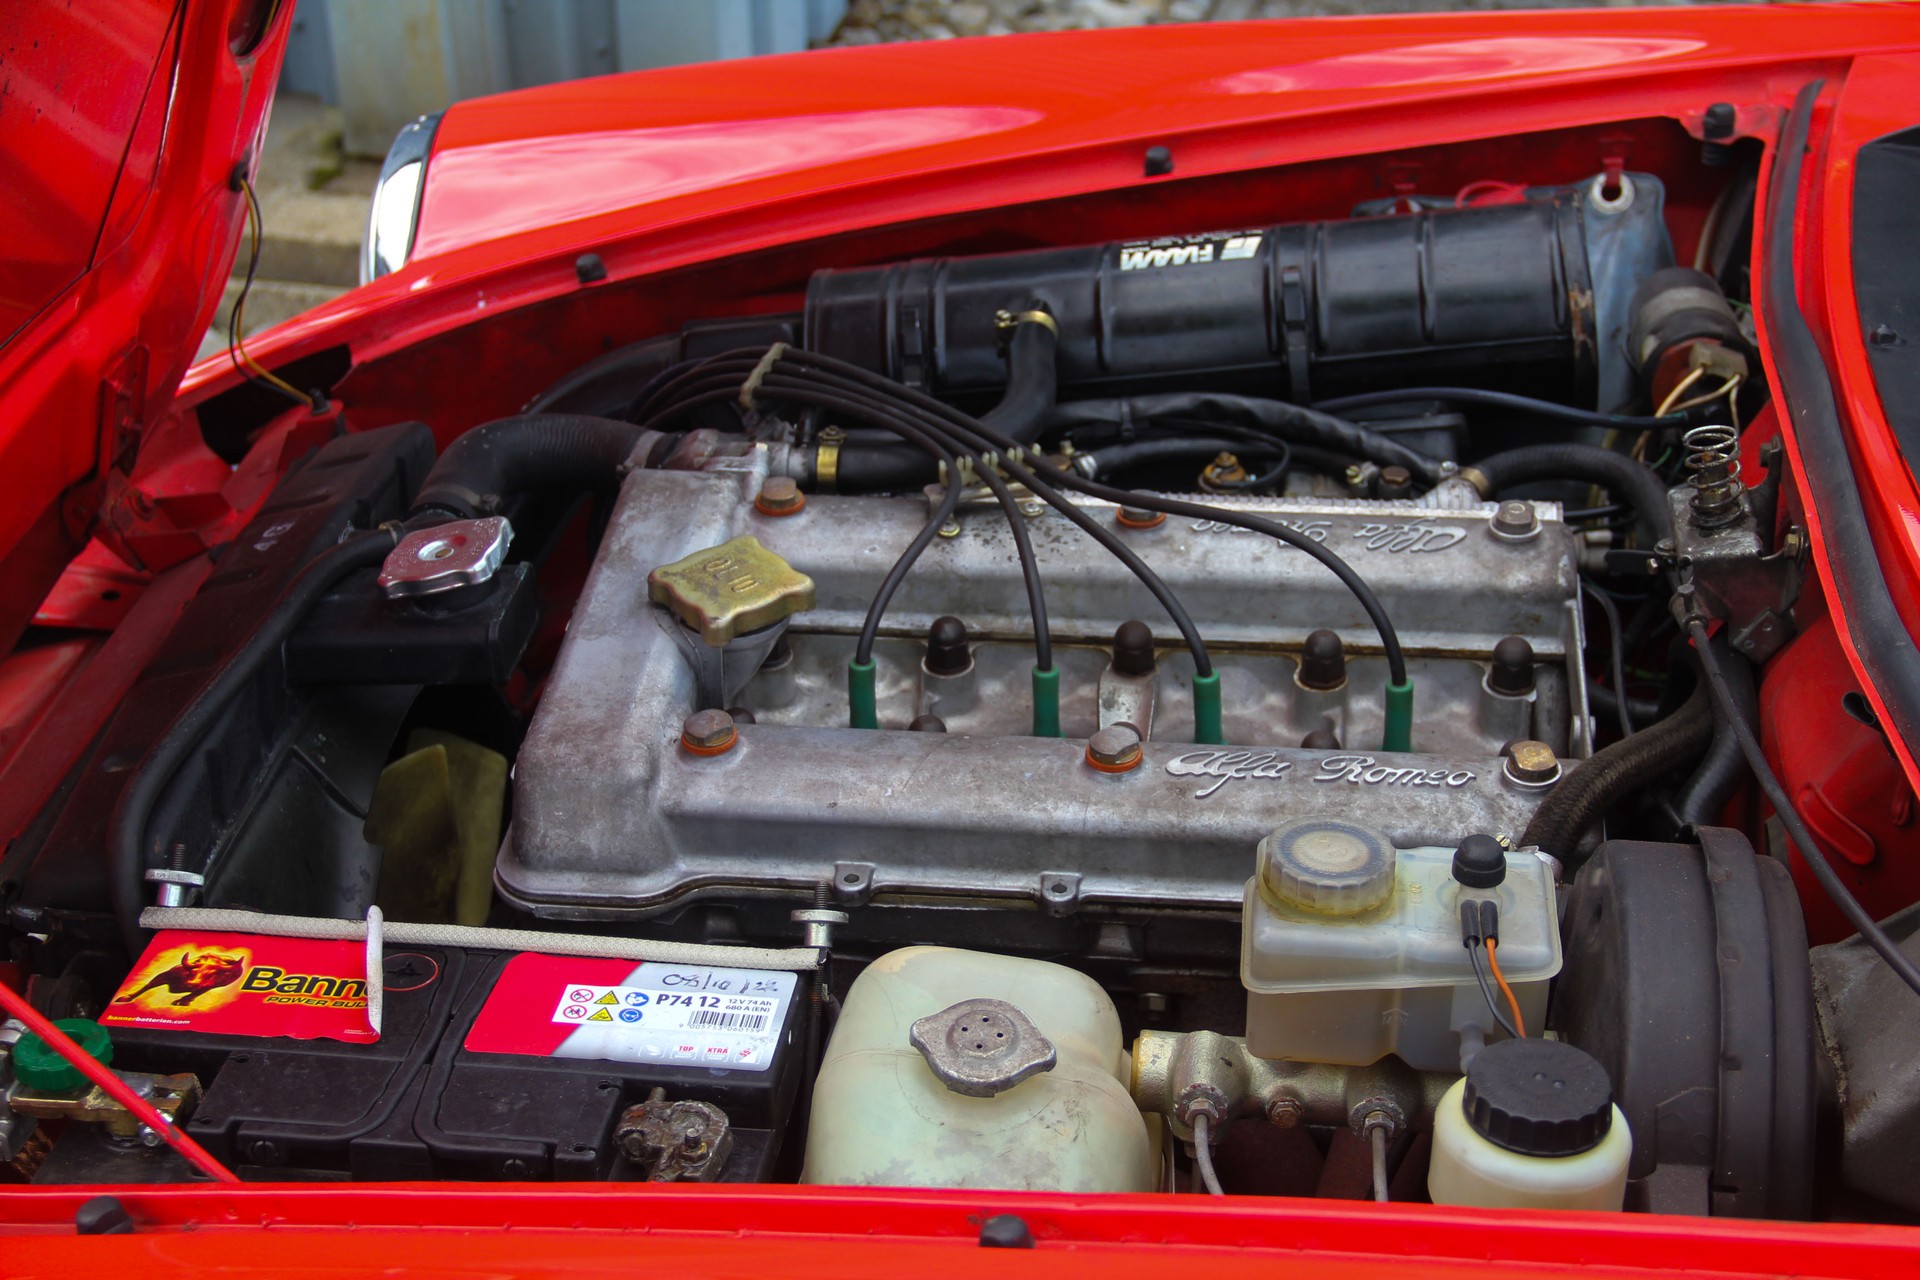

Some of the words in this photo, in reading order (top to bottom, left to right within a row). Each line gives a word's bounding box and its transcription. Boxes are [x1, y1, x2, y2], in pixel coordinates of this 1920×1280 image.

[1120, 243, 1214, 271] FIAAM
[1353, 517, 1467, 553] Alfa
[1165, 751, 1291, 799] Alfa
[1313, 755, 1477, 787] Romeo
[240, 966, 368, 998] Bann
[266, 996, 328, 1006] POWER
[656, 993, 693, 1007] P74
[699, 996, 721, 1009] 12
[106, 1015, 191, 1025] bannerbatterien.com
